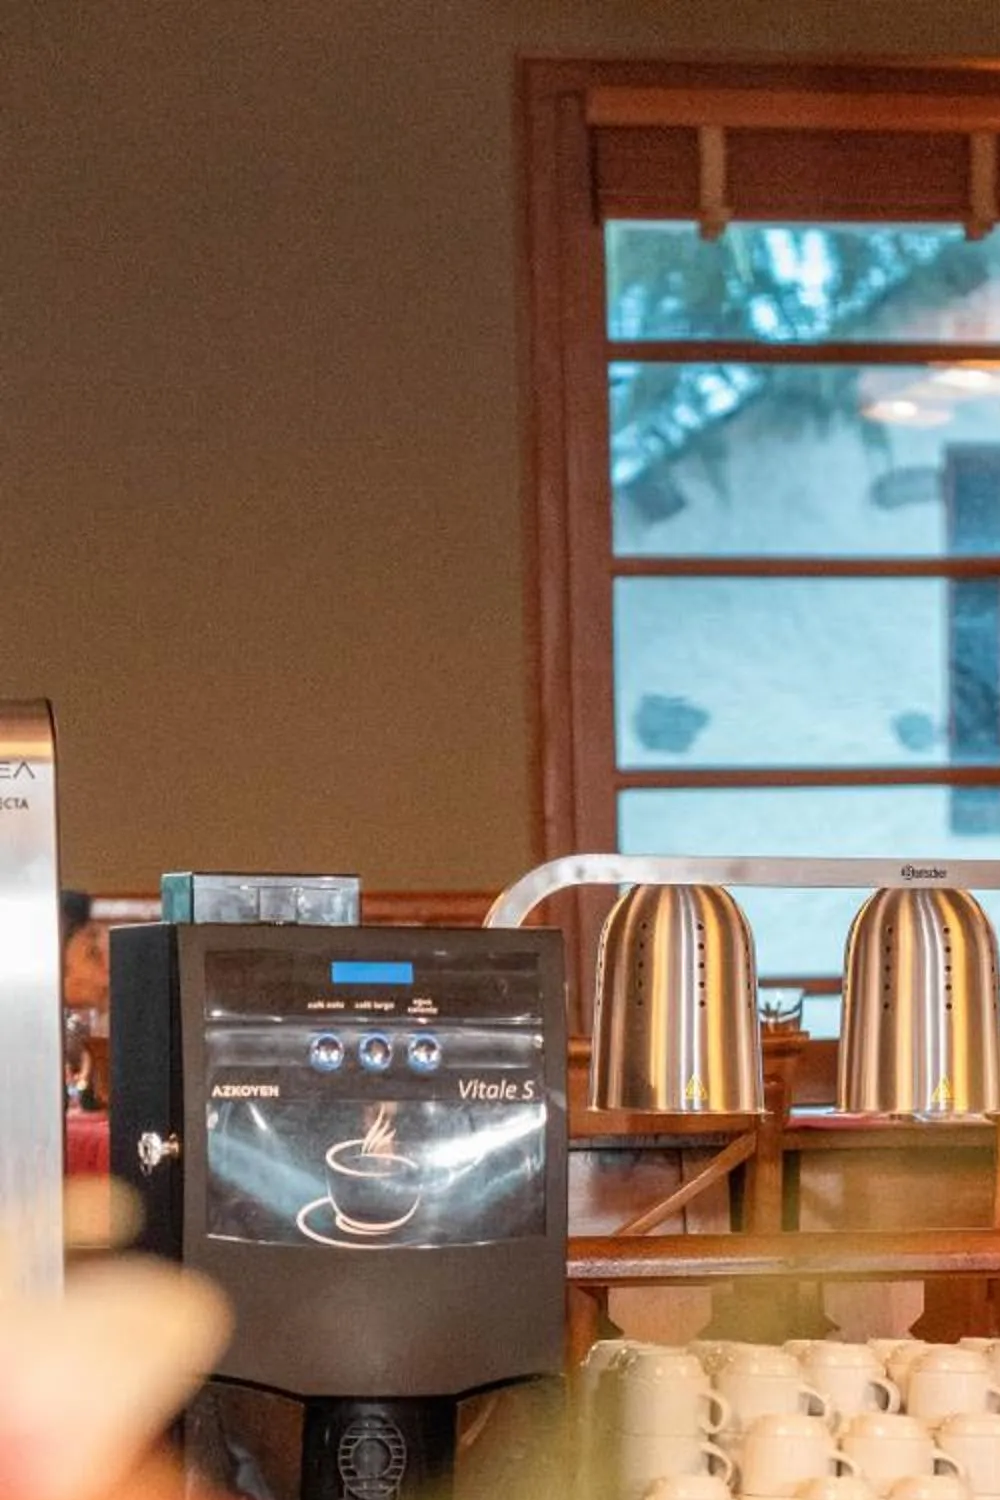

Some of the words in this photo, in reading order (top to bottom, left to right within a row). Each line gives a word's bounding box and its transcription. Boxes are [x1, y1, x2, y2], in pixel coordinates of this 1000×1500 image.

[0, 797, 29, 810] CTA
[211, 1084, 280, 1098] AZKOYEN
[459, 1079, 517, 1099] Vitale
[522, 1080, 535, 1099] S
